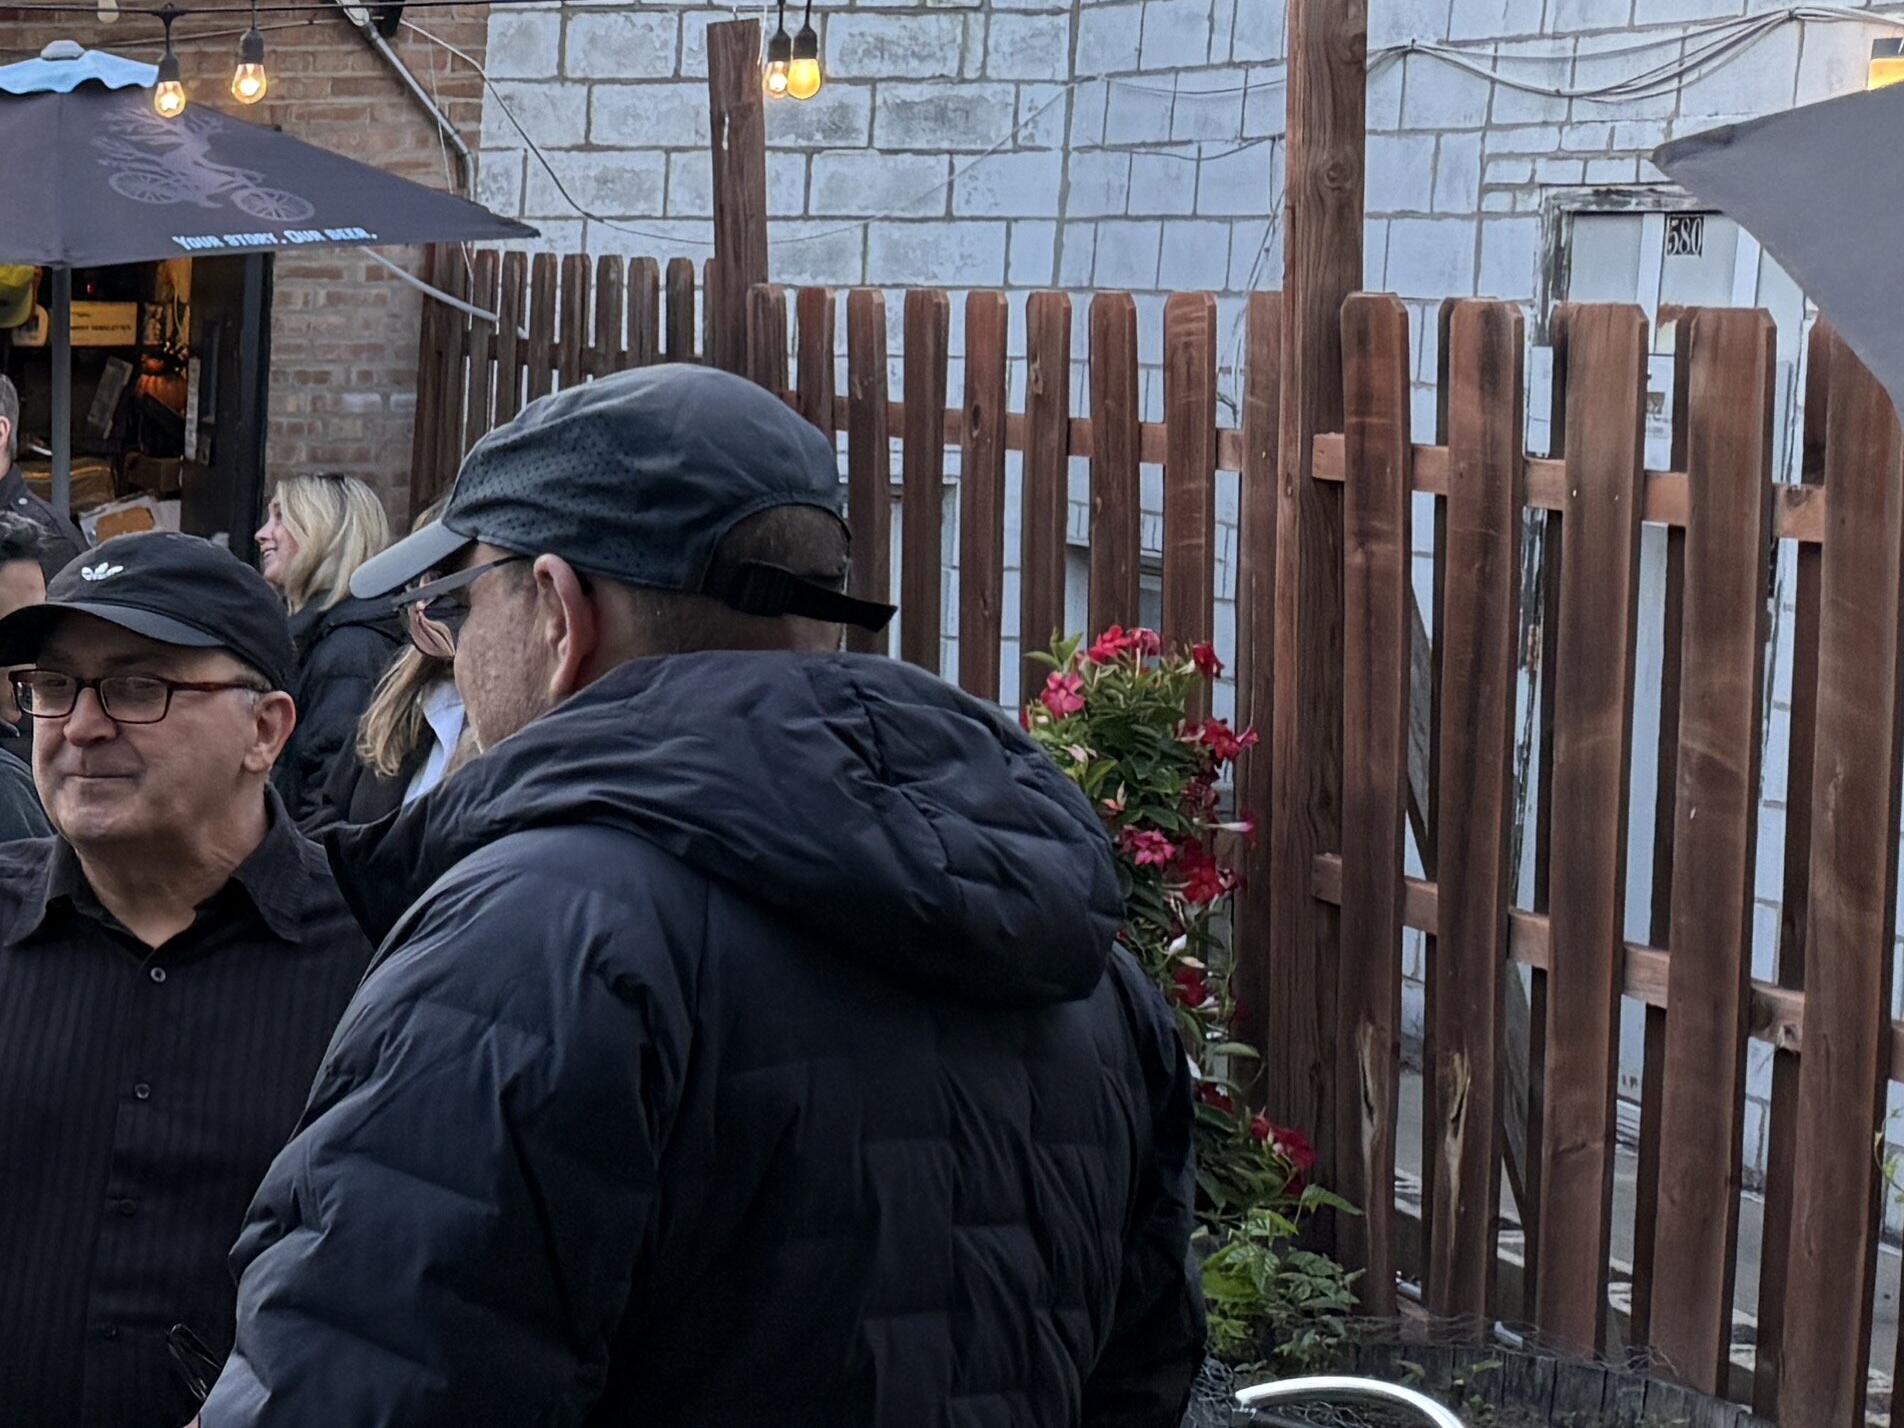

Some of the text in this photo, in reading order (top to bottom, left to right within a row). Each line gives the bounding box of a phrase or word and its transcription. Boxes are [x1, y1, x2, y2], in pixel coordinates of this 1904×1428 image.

[172, 227, 378, 251] YOUR STORY. OUR BEER.
